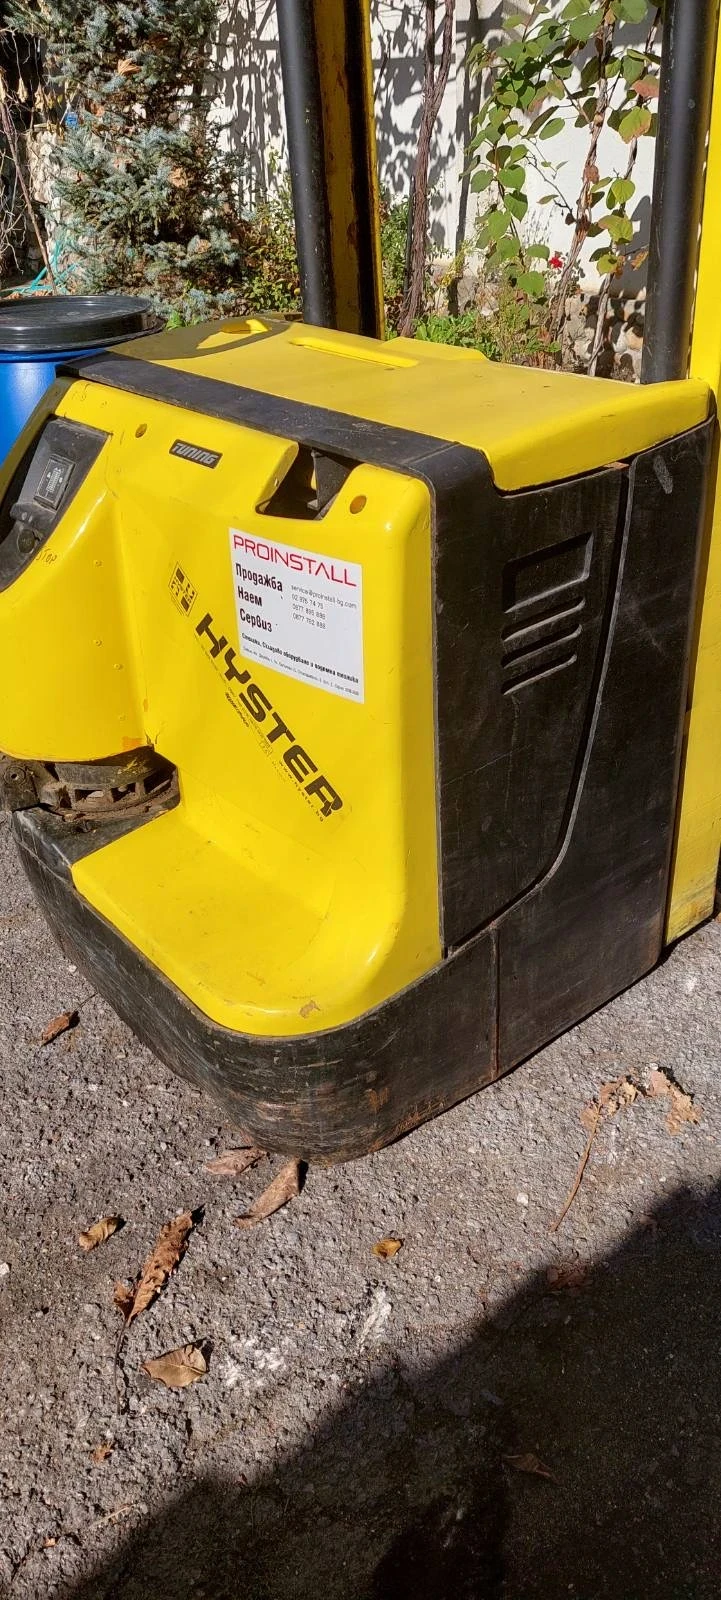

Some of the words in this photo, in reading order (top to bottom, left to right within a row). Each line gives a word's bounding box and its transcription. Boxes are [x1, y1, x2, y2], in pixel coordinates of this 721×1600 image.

[171, 442, 219, 465] TUNING
[233, 534, 357, 587] PROINSTALL
[236, 563, 283, 592] Продажба
[238, 586, 263, 607] Наем
[239, 607, 272, 633] Сервиз
[195, 612, 343, 819] HYSTER
